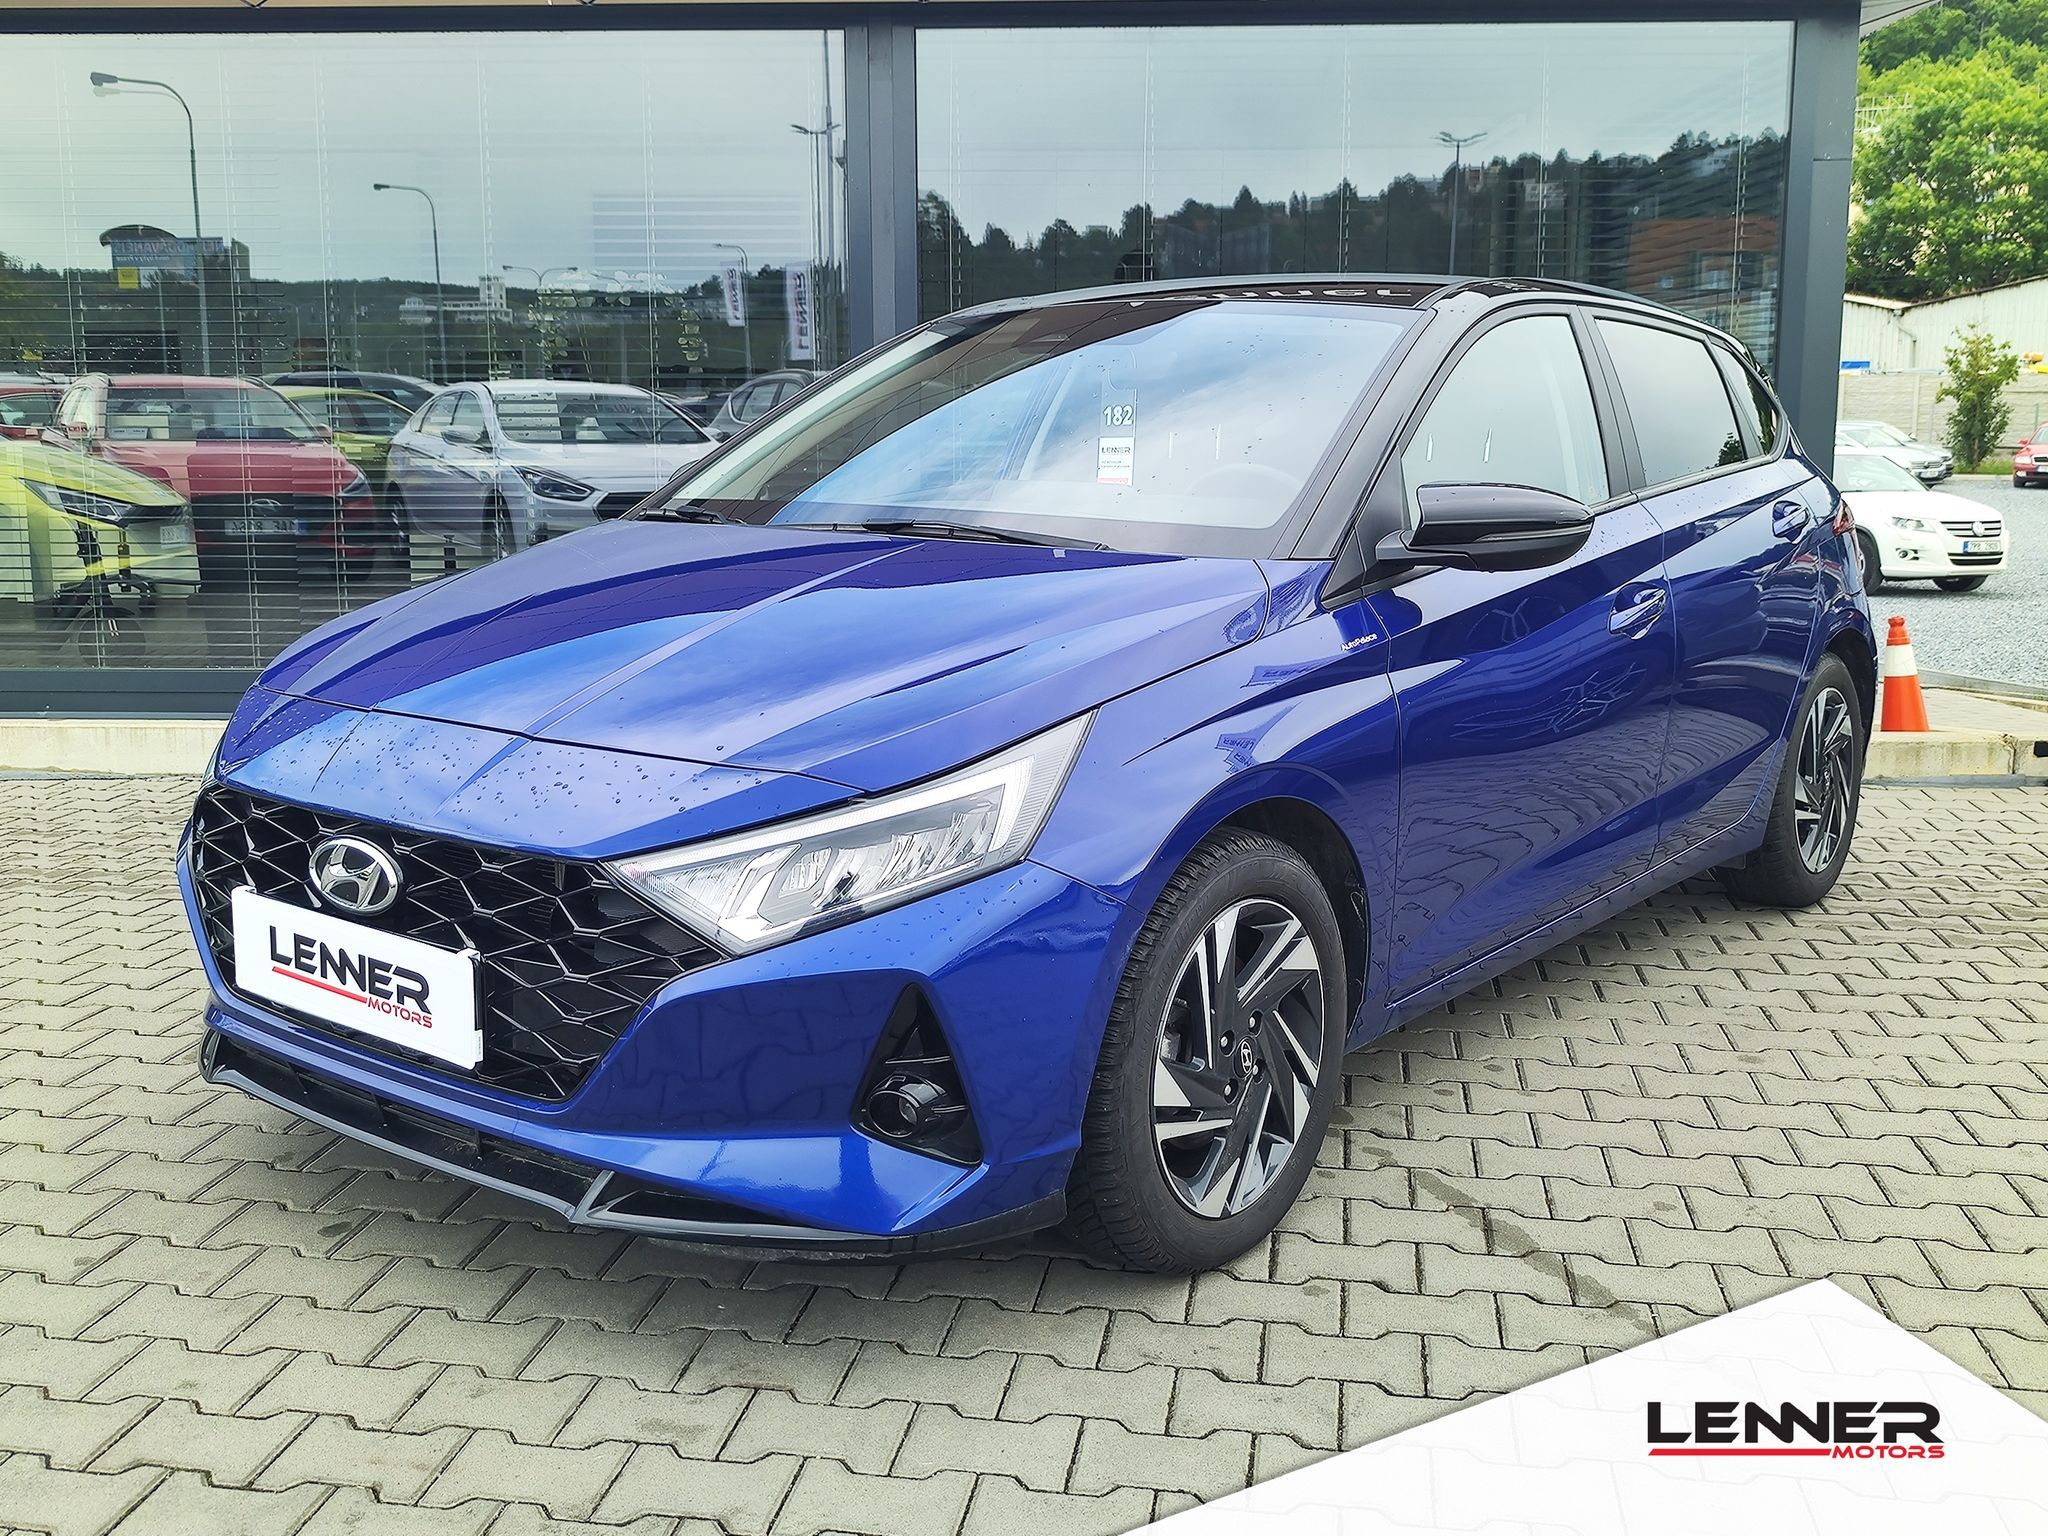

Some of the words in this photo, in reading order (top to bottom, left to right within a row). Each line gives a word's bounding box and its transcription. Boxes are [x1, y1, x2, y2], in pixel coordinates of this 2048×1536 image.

[1103, 405, 1134, 427] 182
[269, 925, 432, 1015] LENNER
[367, 996, 433, 1029] MOTORS
